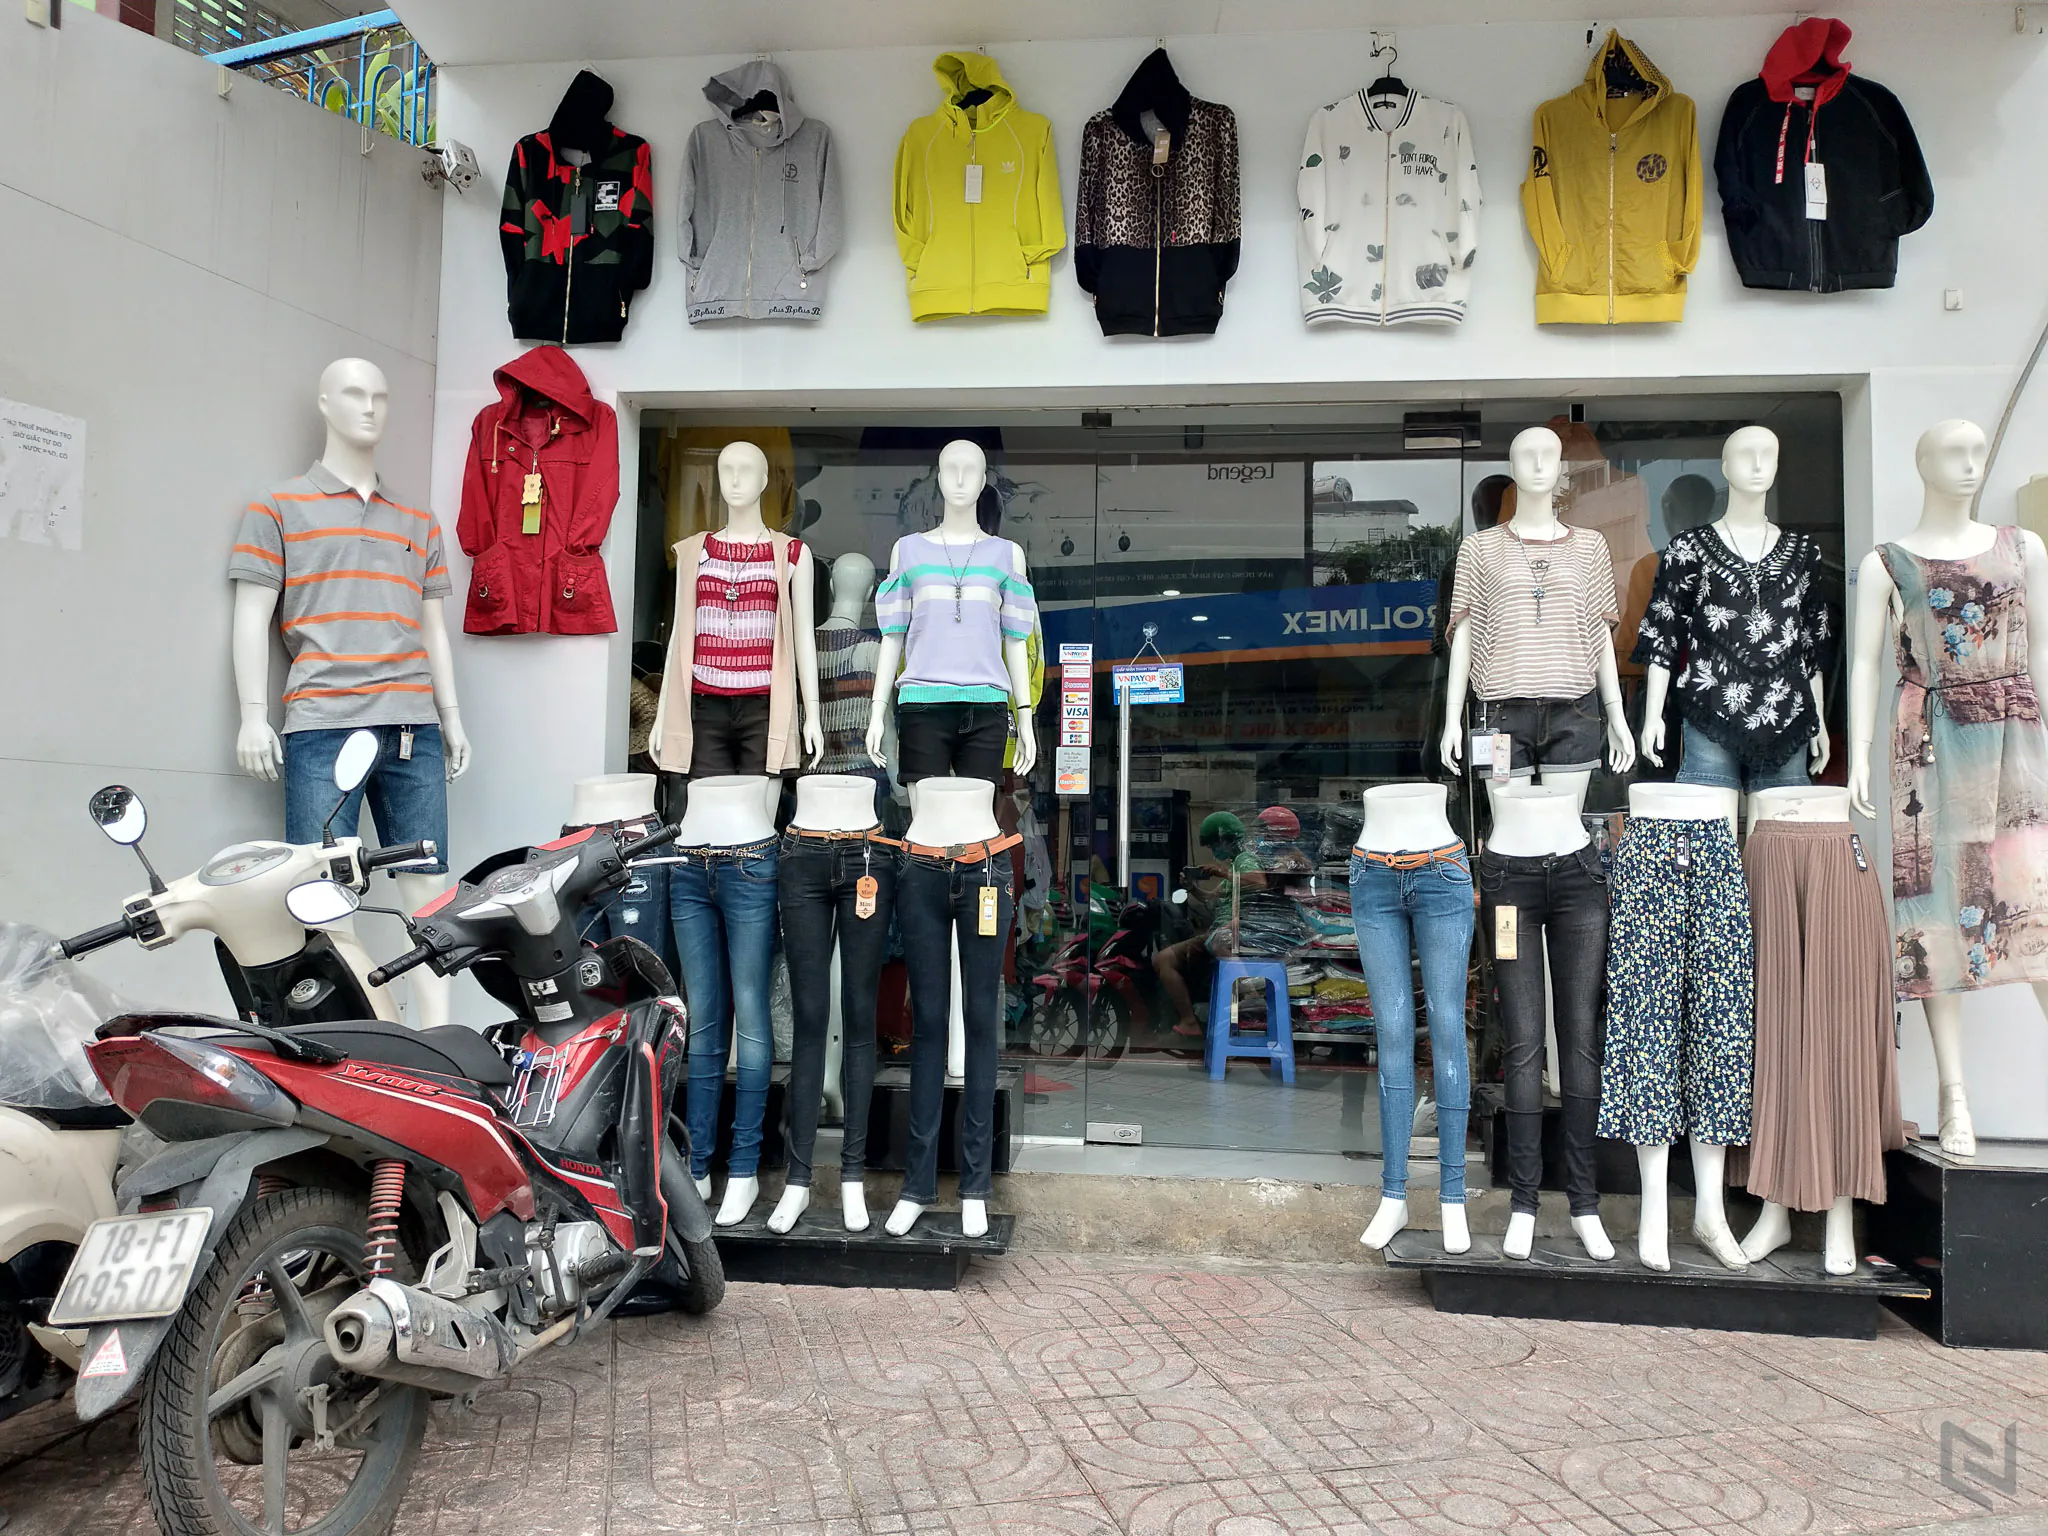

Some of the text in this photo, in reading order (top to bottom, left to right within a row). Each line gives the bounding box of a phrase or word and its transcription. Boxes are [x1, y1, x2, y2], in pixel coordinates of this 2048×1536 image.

[1403, 165, 1434, 177] TO HAVE
[1117, 674, 1157, 683] VNPAYQR
[1066, 707, 1089, 716] VISA
[560, 1158, 603, 1177] HONDA
[99, 1216, 190, 1266] 18-F1
